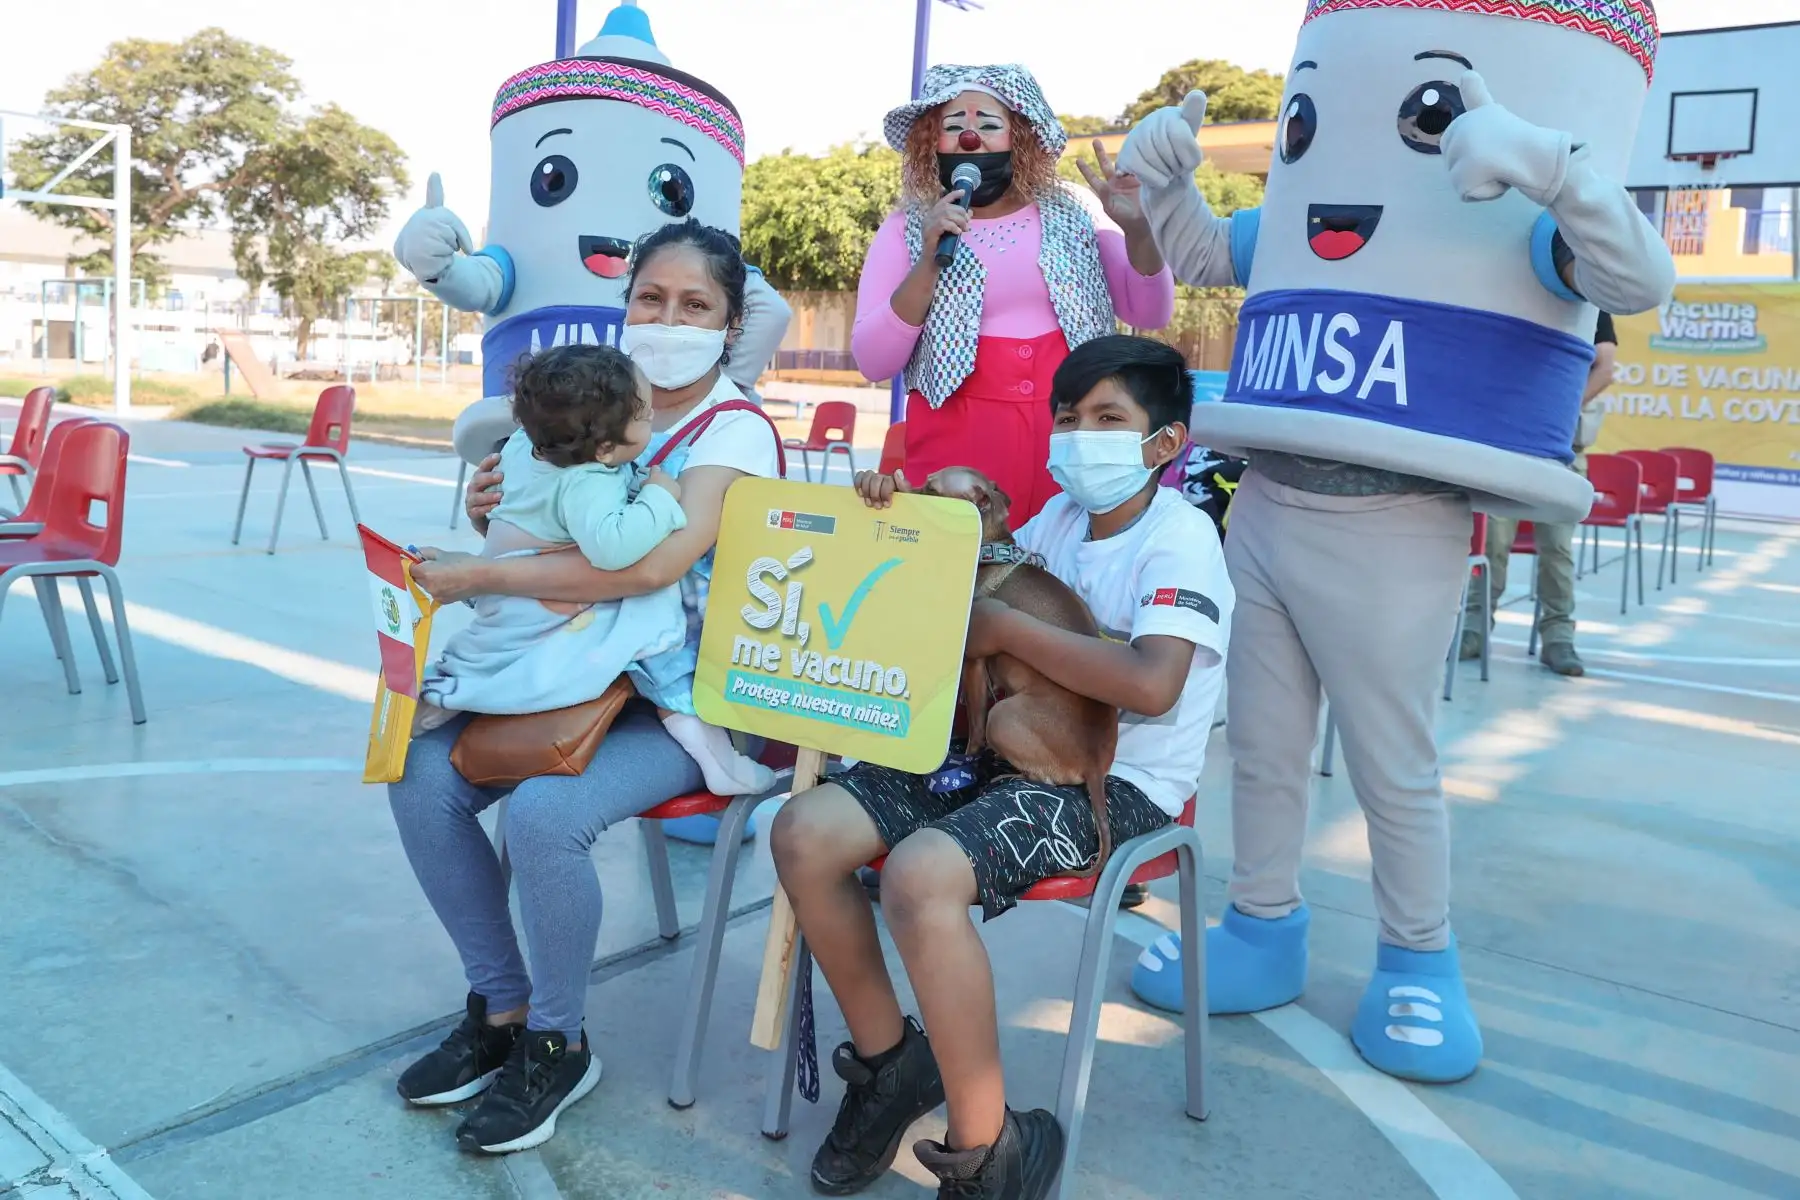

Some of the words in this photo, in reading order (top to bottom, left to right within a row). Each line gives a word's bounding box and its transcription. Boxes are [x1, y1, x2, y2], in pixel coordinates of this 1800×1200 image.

[1659, 301, 1756, 320] Vacuna
[1661, 317, 1755, 340] Warma
[1236, 312, 1408, 406] MINSA
[1653, 363, 1688, 387] DE
[1599, 392, 1674, 419] NTRA
[1681, 395, 1715, 421] LA
[889, 525, 920, 537] Siempre
[740, 546, 813, 646] Sí,
[731, 635, 782, 672] me
[790, 648, 911, 699] vacuno.
[732, 676, 791, 708] Protege
[791, 692, 851, 720] nuestra
[853, 702, 900, 730] niñez
